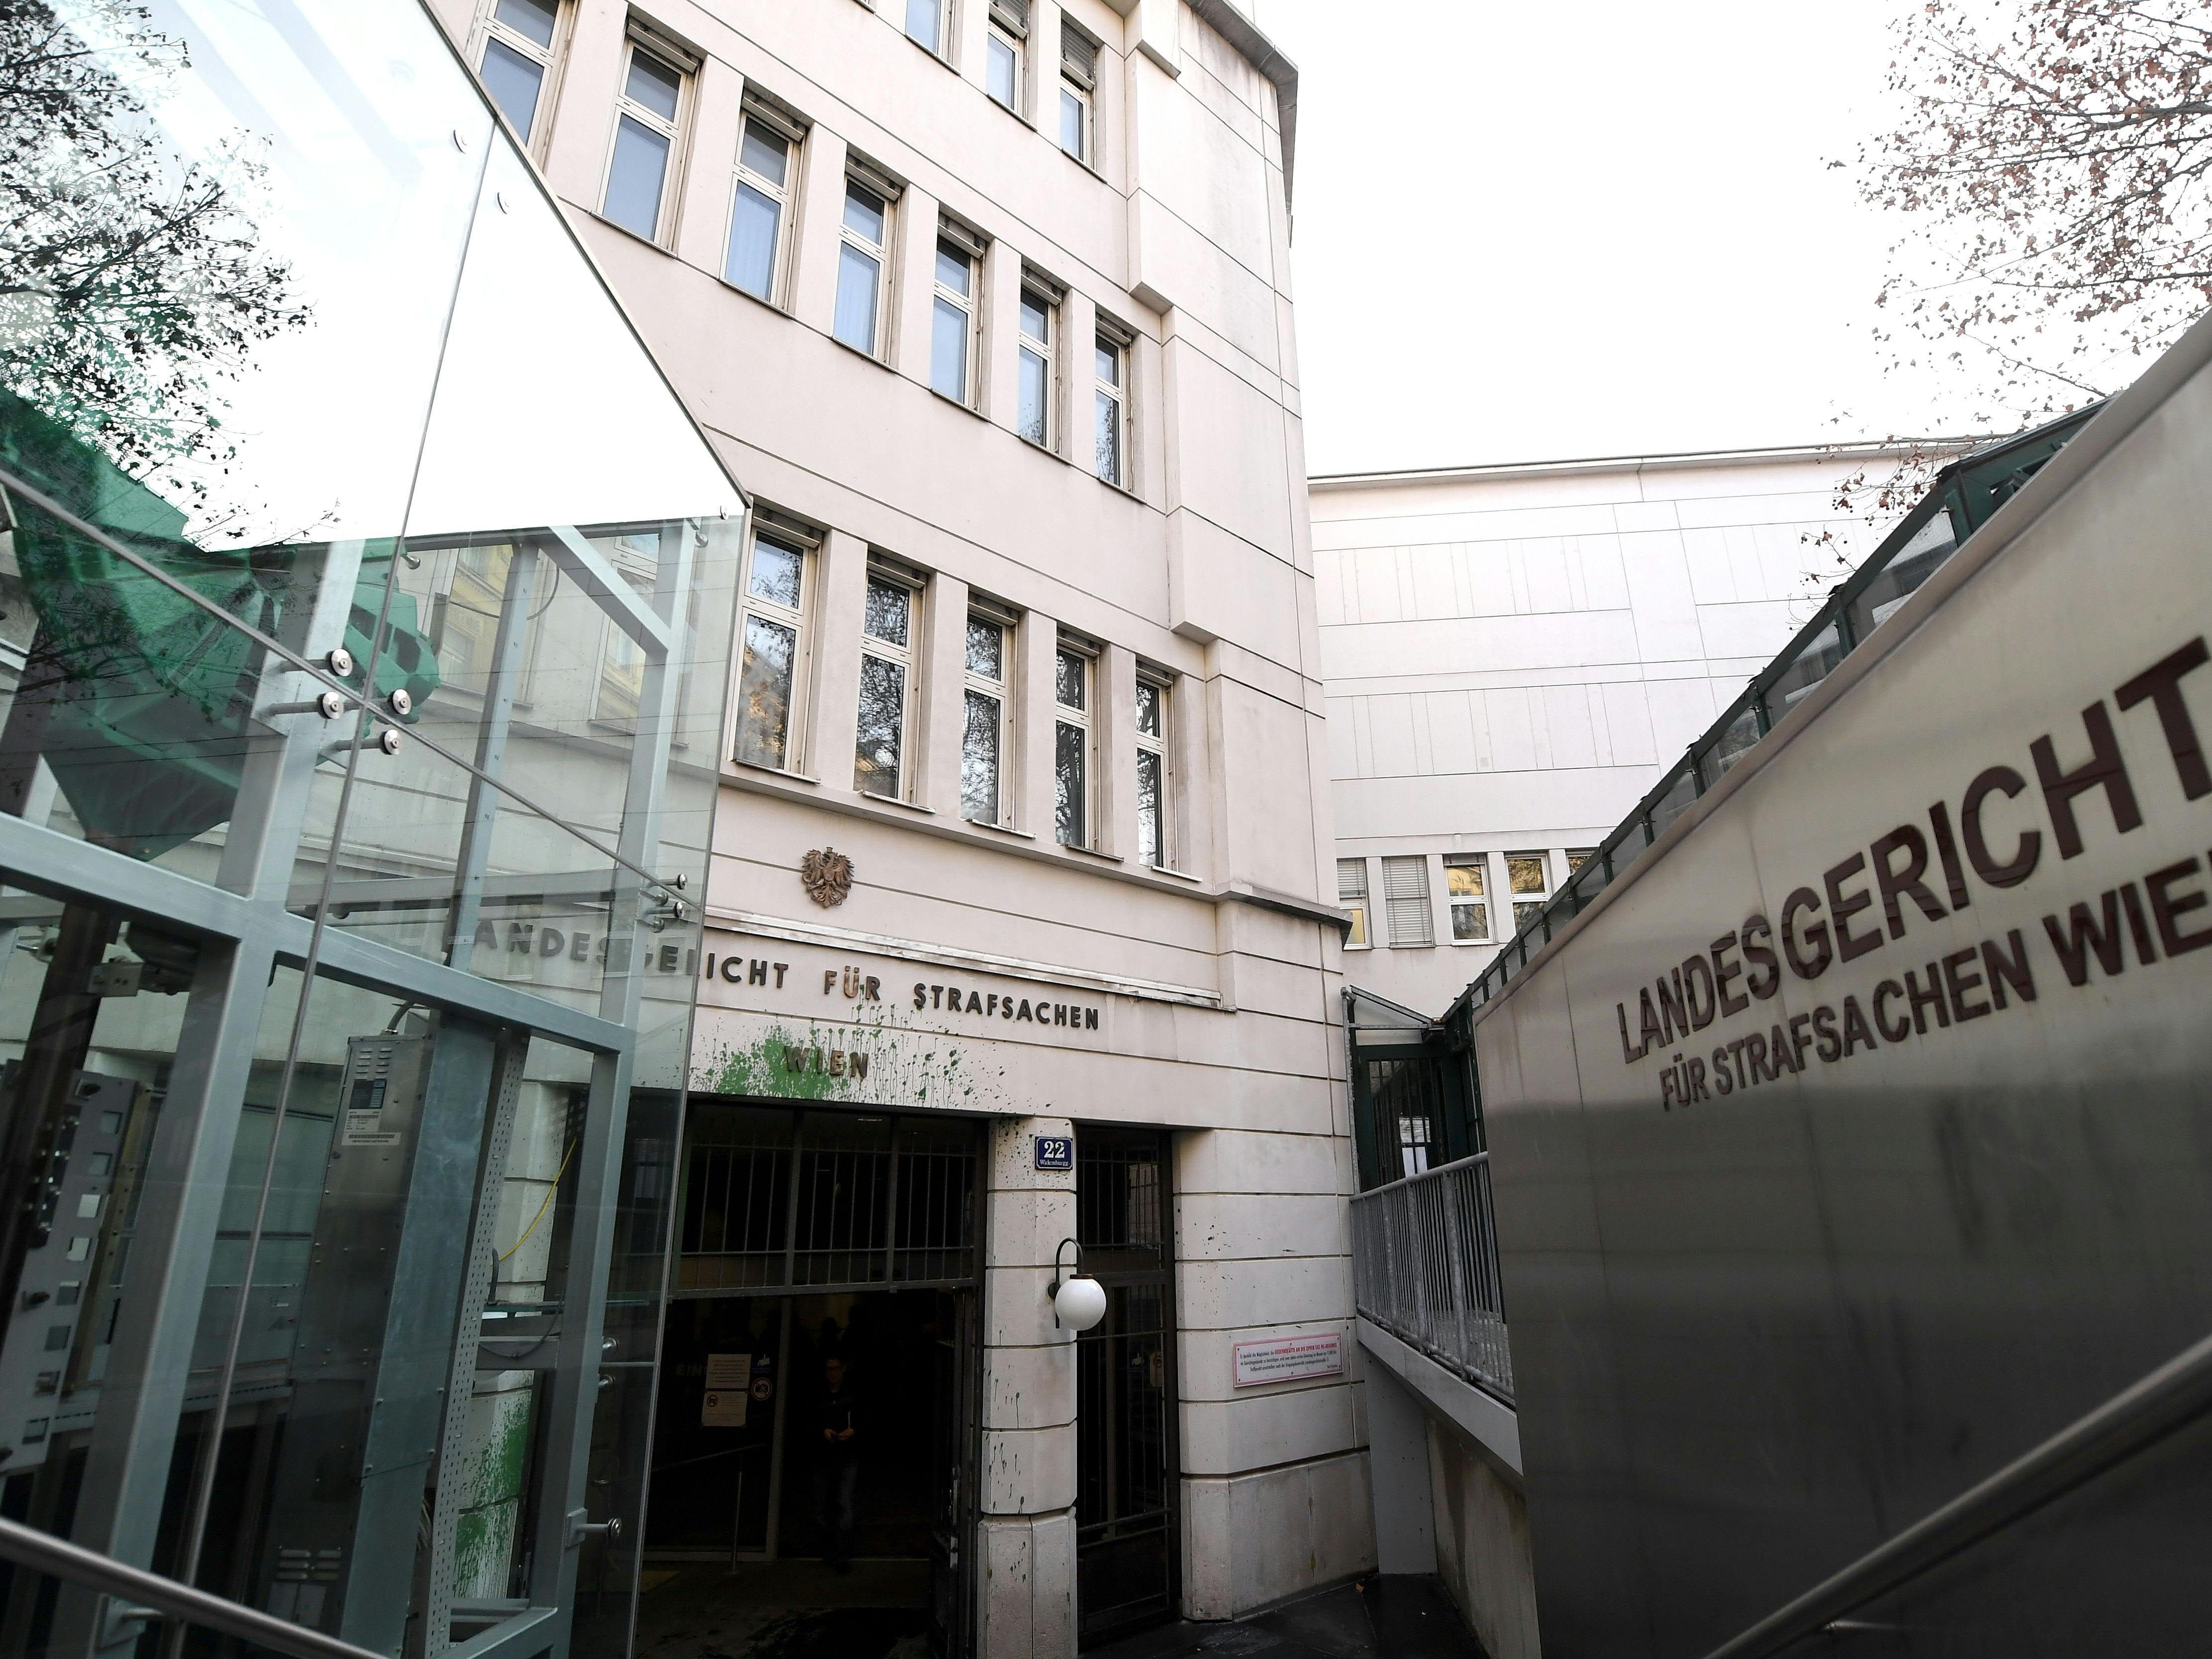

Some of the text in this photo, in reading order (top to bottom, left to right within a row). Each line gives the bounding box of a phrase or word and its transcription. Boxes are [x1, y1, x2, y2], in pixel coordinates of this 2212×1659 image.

[1617, 635, 2212, 1064] LANDESGERICHT
[824, 966, 880, 1001] FÜR
[913, 982, 1099, 1030] STRAFSACHEN
[1659, 850, 2212, 1112] FÜR STRAFSACHEN WIE
[784, 1045, 869, 1078] WIEN
[1044, 1141, 1065, 1159] 22
